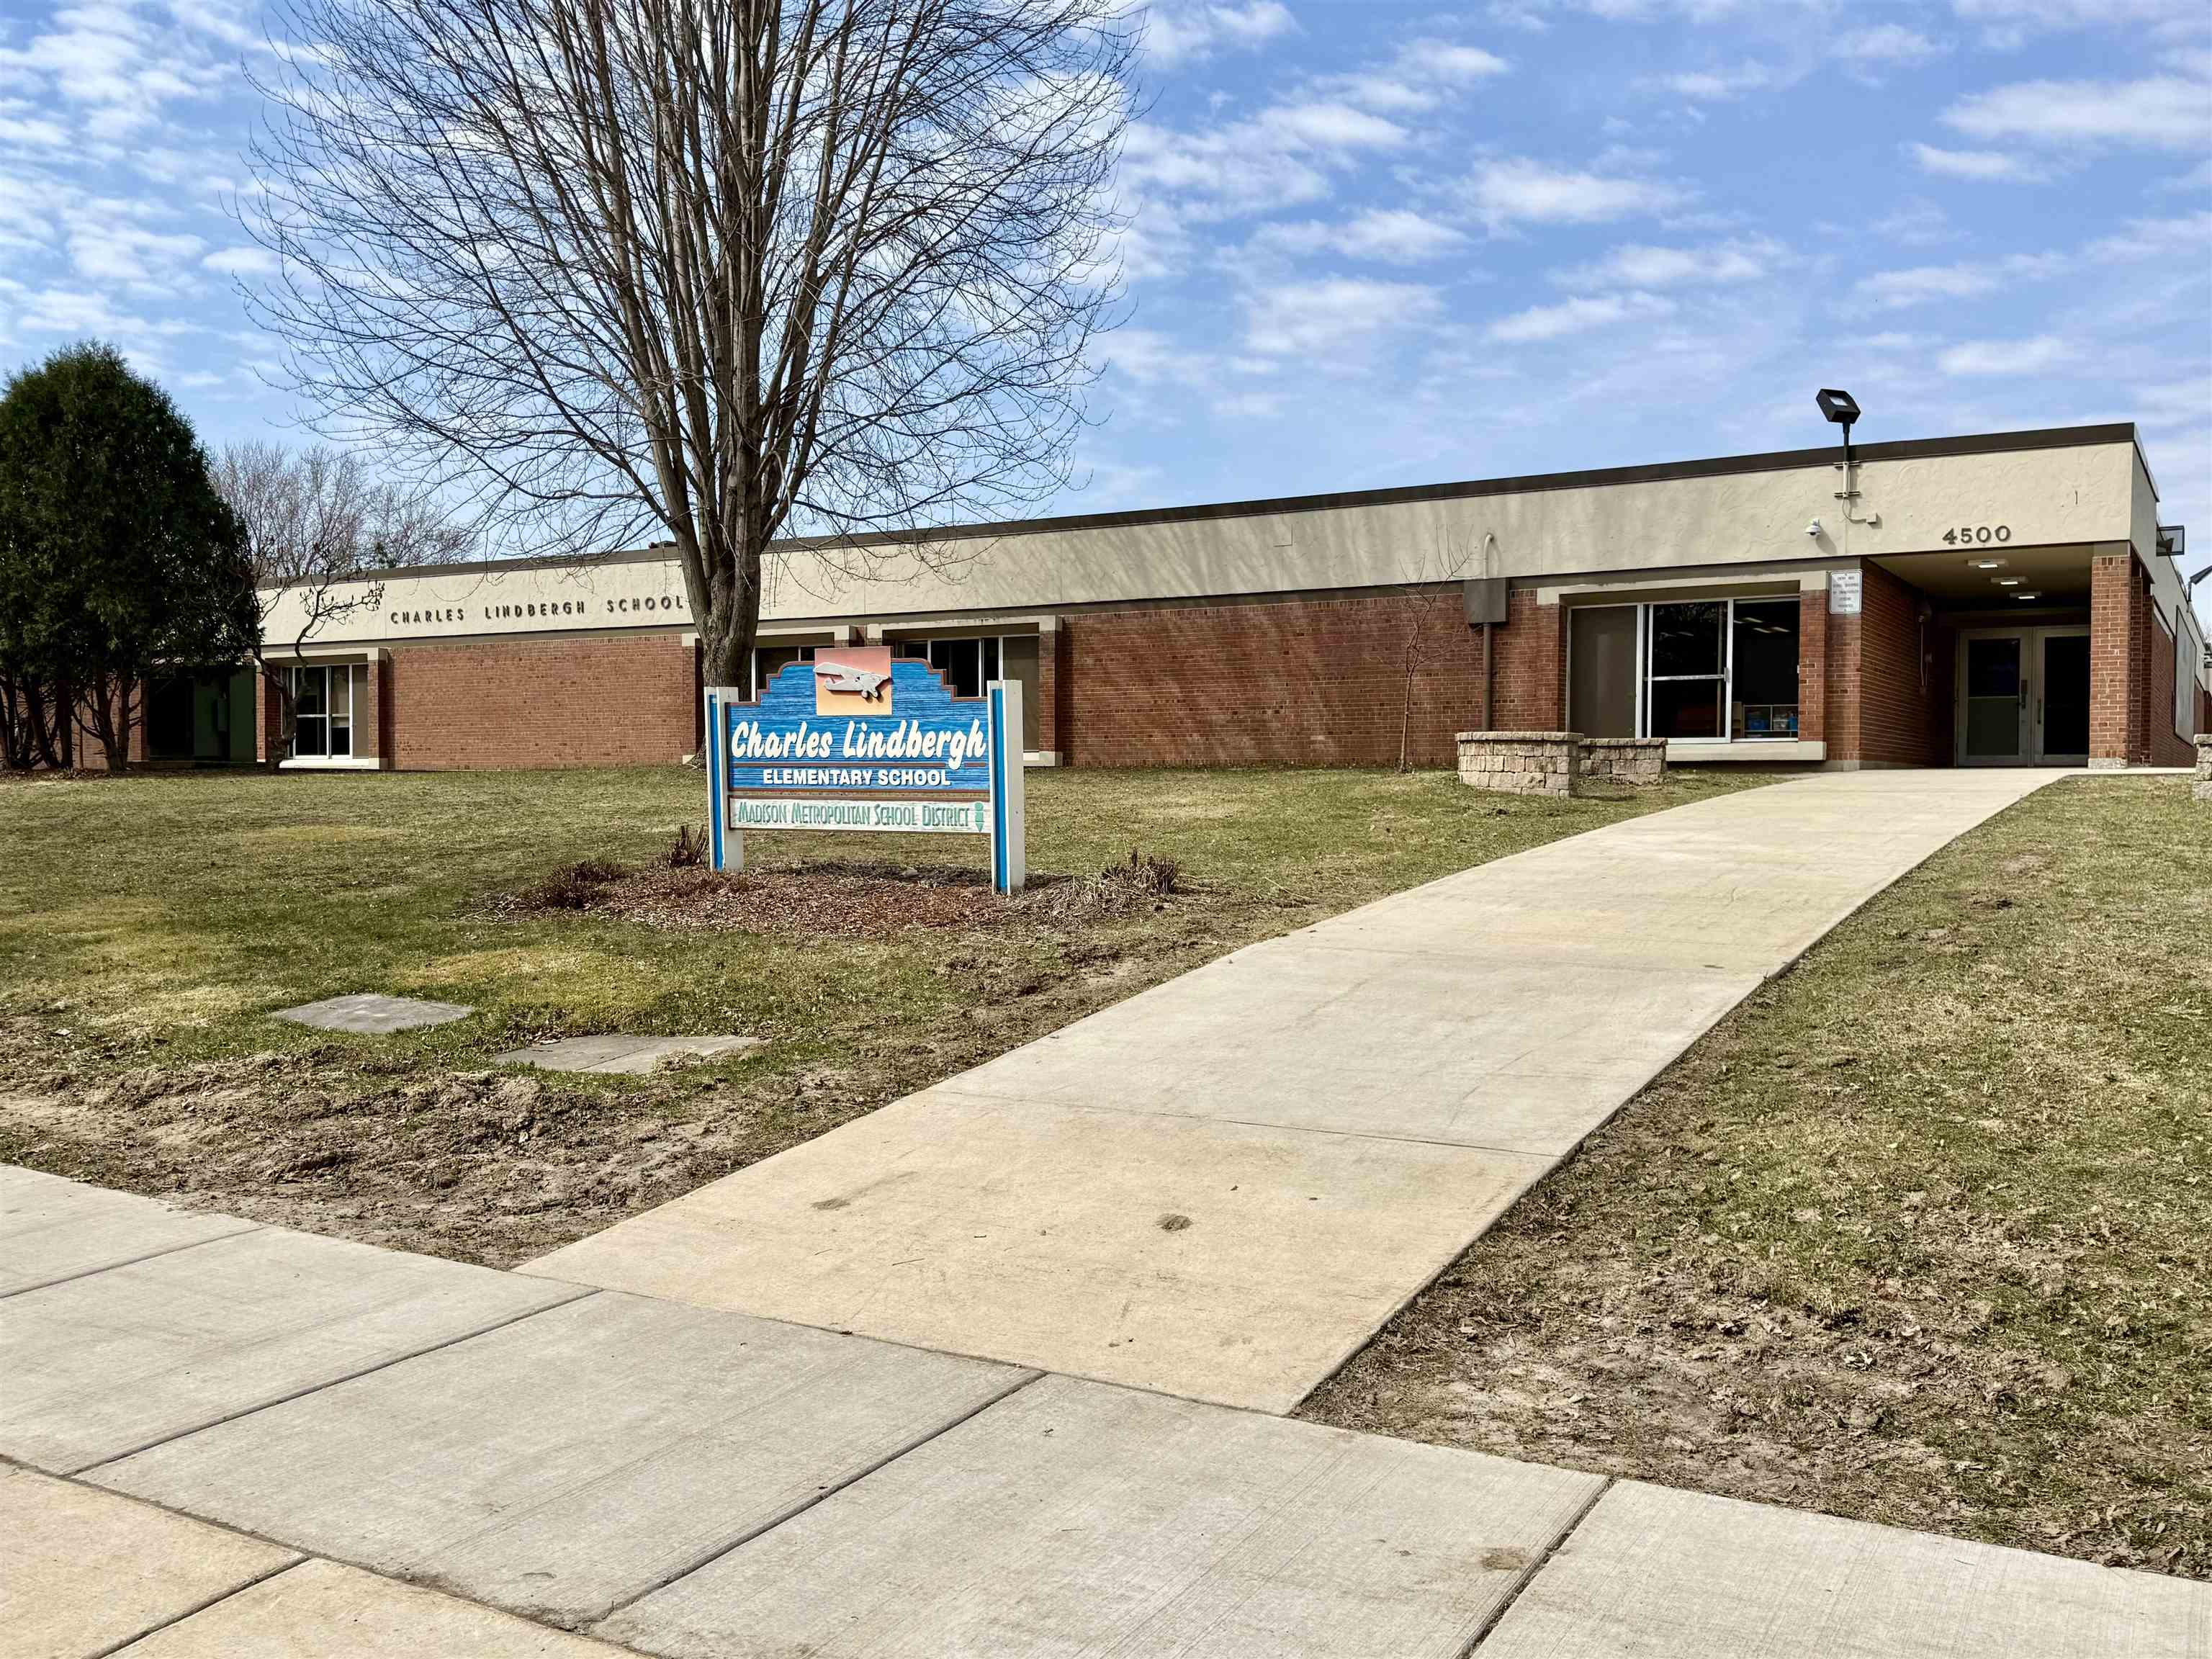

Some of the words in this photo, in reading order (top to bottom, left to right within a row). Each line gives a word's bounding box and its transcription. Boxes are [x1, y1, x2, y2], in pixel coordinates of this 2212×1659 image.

[1942, 526, 2011, 545] 4500
[390, 608, 464, 624] CHARLES
[485, 601, 585, 619] LINDBERGH
[607, 595, 683, 613] SCHOOL
[732, 721, 833, 758] Charles
[842, 719, 986, 770] Lindbergh
[763, 769, 873, 785] ELEMENTARY
[878, 769, 951, 786] SCHOOL
[738, 801, 787, 823] MADISON
[791, 802, 870, 824] METROPOLITAN
[874, 804, 918, 825] SCHOOL
[922, 804, 970, 827] DISTRICT
